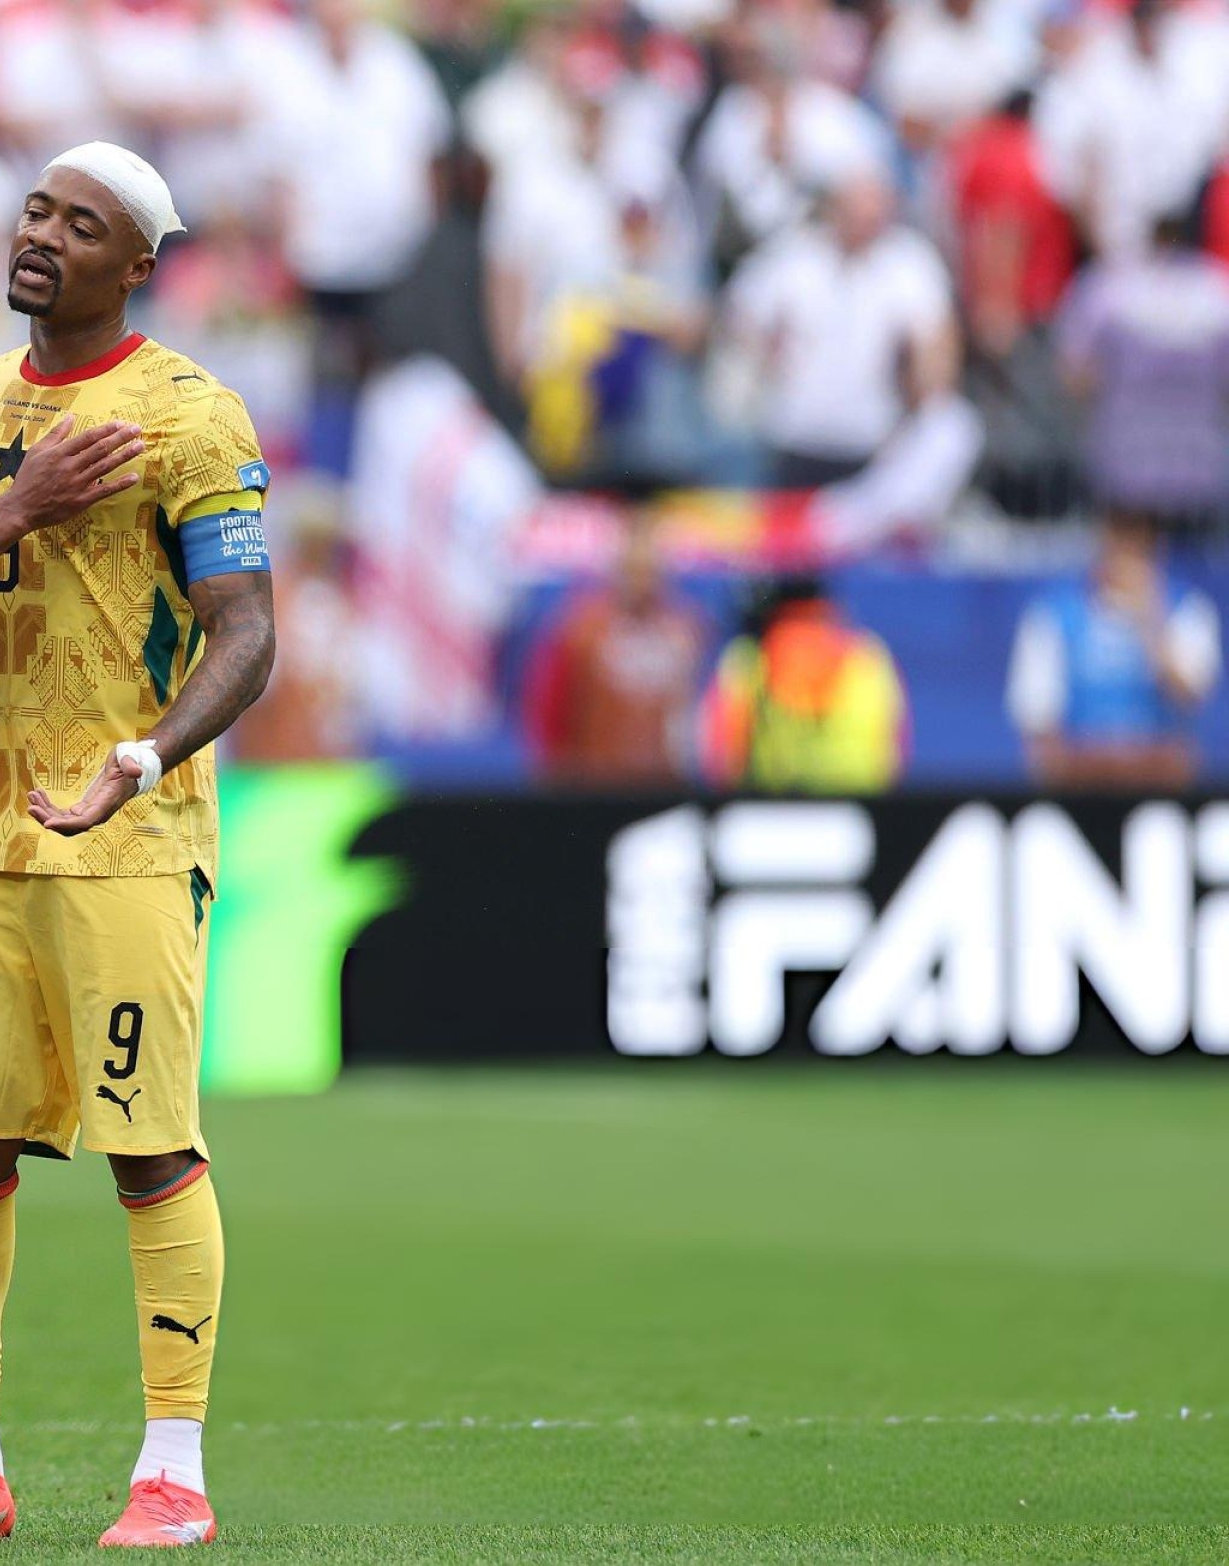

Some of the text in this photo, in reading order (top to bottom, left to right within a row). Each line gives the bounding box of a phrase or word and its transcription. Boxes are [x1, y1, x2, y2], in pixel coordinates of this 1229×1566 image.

[219, 515, 262, 528] FOOTBAL
[221, 527, 265, 543] UNITE
[220, 541, 268, 557] the Worl
[709, 799, 1229, 1056] FAN
[104, 1002, 143, 1079] 9
